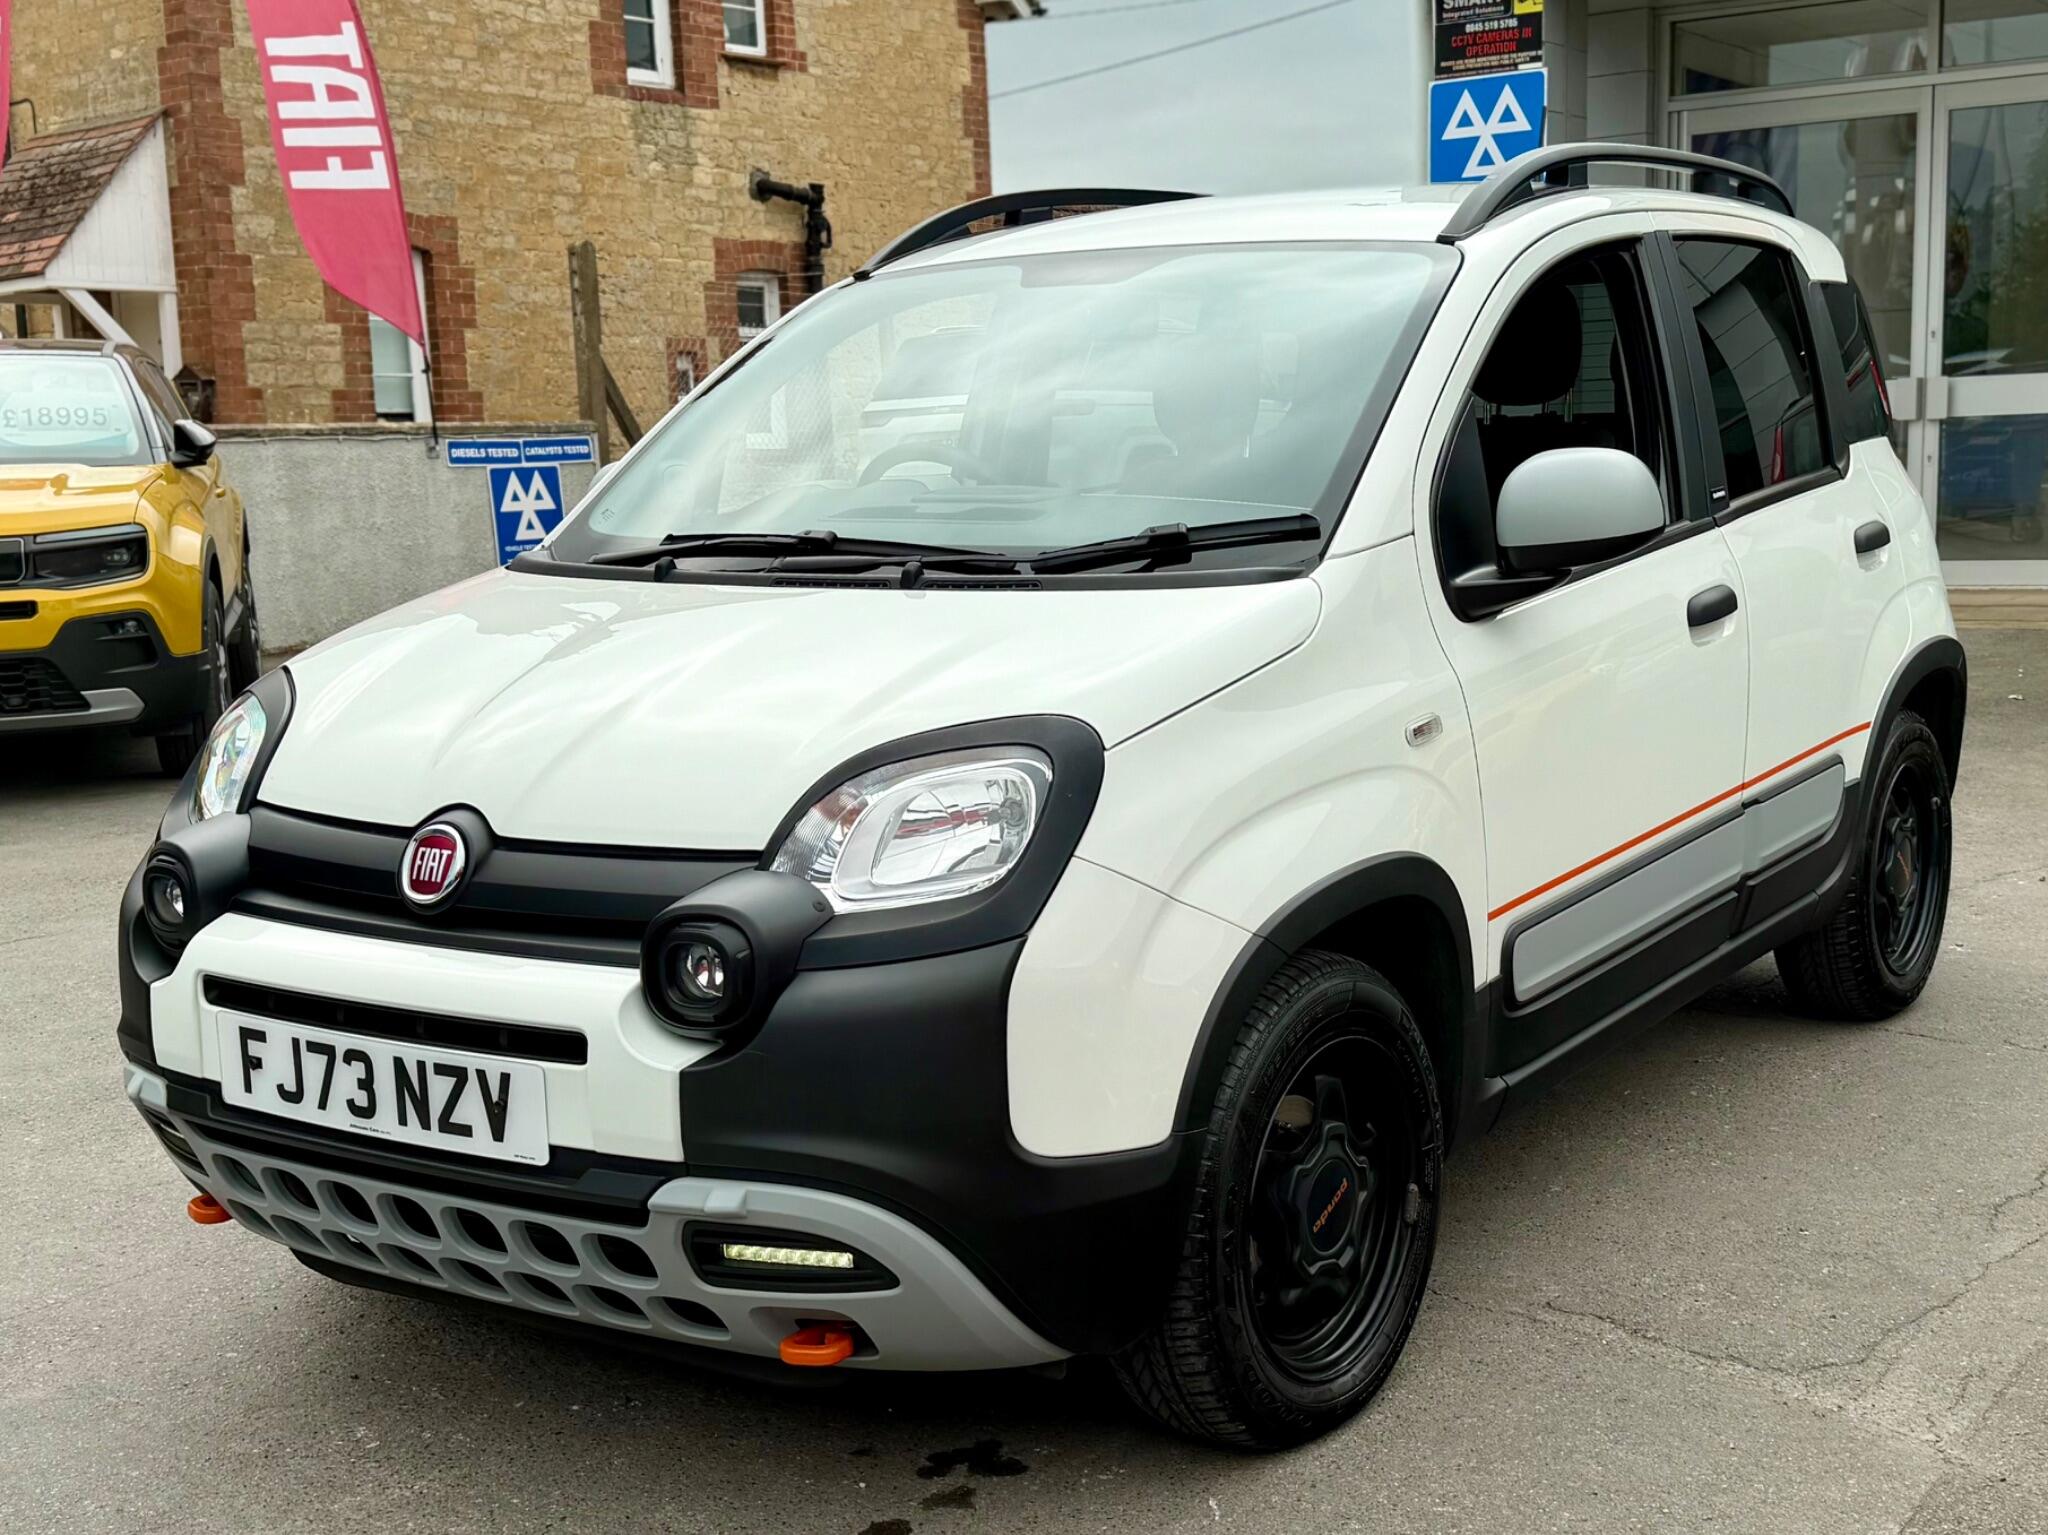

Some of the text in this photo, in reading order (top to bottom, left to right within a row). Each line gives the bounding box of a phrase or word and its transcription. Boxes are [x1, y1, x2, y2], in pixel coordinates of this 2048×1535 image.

[1451, 26, 1533, 47] CCTV CAMERAS IN
[1466, 41, 1516, 57] OPERATION
[3, 406, 108, 428] £18995
[451, 448, 519, 458] DIESELS TESTED
[525, 445, 589, 456] CATALYSTS TESTED
[412, 846, 453, 883] FIAT
[238, 1026, 511, 1144] FJ73 NZV
[1312, 1177, 1349, 1233] panda
